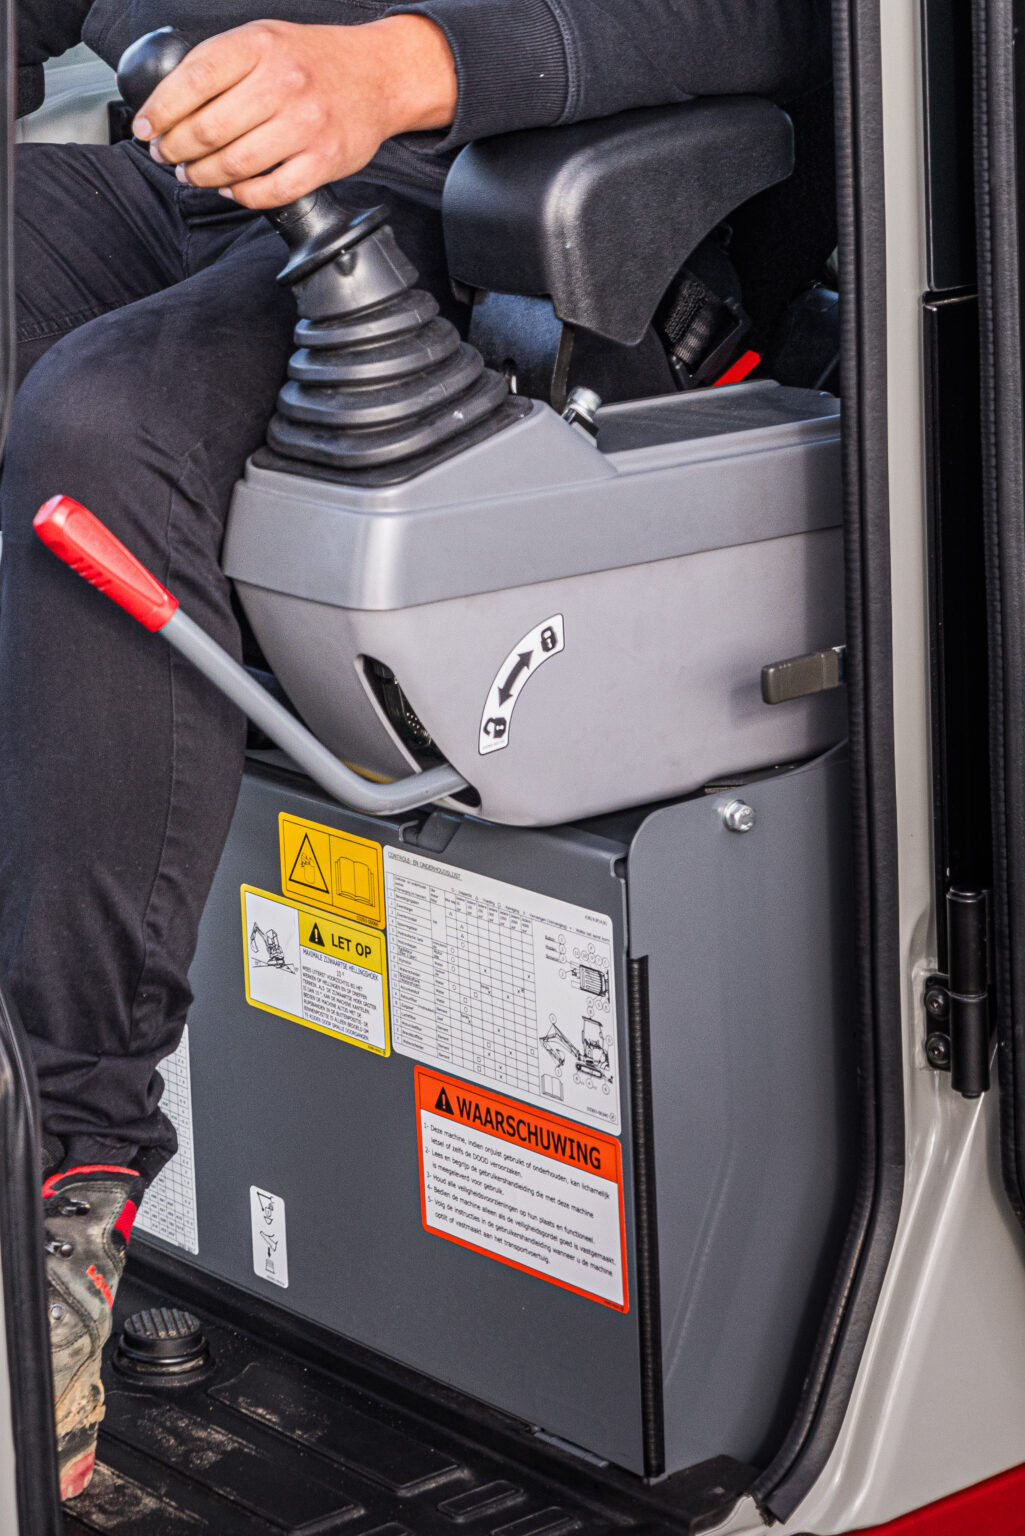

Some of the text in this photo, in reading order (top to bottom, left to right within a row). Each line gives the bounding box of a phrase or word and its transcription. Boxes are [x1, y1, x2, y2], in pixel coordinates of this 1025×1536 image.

[331, 933, 372, 958] LET OP
[430, 1124, 443, 1135] Deze
[444, 1131, 467, 1145] machine,
[468, 1140, 483, 1150] indien
[485, 1146, 502, 1158] onjuist
[503, 1154, 525, 1166] gebruikt
[532, 1165, 569, 1184] onderhouden,
[570, 1179, 580, 1187] kan
[581, 1183, 610, 1200] lichamelijk
[431, 1139, 444, 1147] letsel
[452, 1146, 464, 1155] zelfs
[472, 1153, 489, 1165] DOOD
[490, 1162, 521, 1177] veroorzaken.
[456, 1096, 601, 1170] WAARSCHUWING
[432, 1150, 443, 1159] Lees
[452, 1158, 470, 1170] begrijp
[471, 1165, 477, 1173] de
[478, 1169, 535, 1197] gebruikershandleiding
[536, 1191, 544, 1199] die
[545, 1195, 556, 1203] met
[557, 1199, 570, 1209] deze
[571, 1205, 594, 1218] machine
[433, 1174, 447, 1185] Houd
[527, 1212, 538, 1221] hun
[539, 1217, 555, 1228] plaats
[438, 1165, 470, 1182] meegeleverd
[471, 1178, 482, 1186] voor
[483, 1183, 504, 1195] gebruik.
[434, 1186, 450, 1197] Bedien
[452, 1194, 459, 1202] de
[459, 1197, 481, 1211] machine
[482, 1207, 496, 1216] alleen
[498, 1213, 506, 1221] als
[507, 1216, 513, 1224] de
[515, 1221, 558, 1242] veiligheidsgordel
[559, 1238, 573, 1248] goed
[580, 1247, 615, 1265] vastgemaakt.
[435, 1199, 446, 1210] Volg
[454, 1208, 480, 1222] instructies
[495, 1224, 552, 1253] gebruikershandleiding
[553, 1248, 575, 1261] wanneer
[582, 1259, 589, 1267] de
[590, 1263, 613, 1276] machine
[456, 1221, 482, 1235] vastmaakt
[494, 1236, 503, 1244] het
